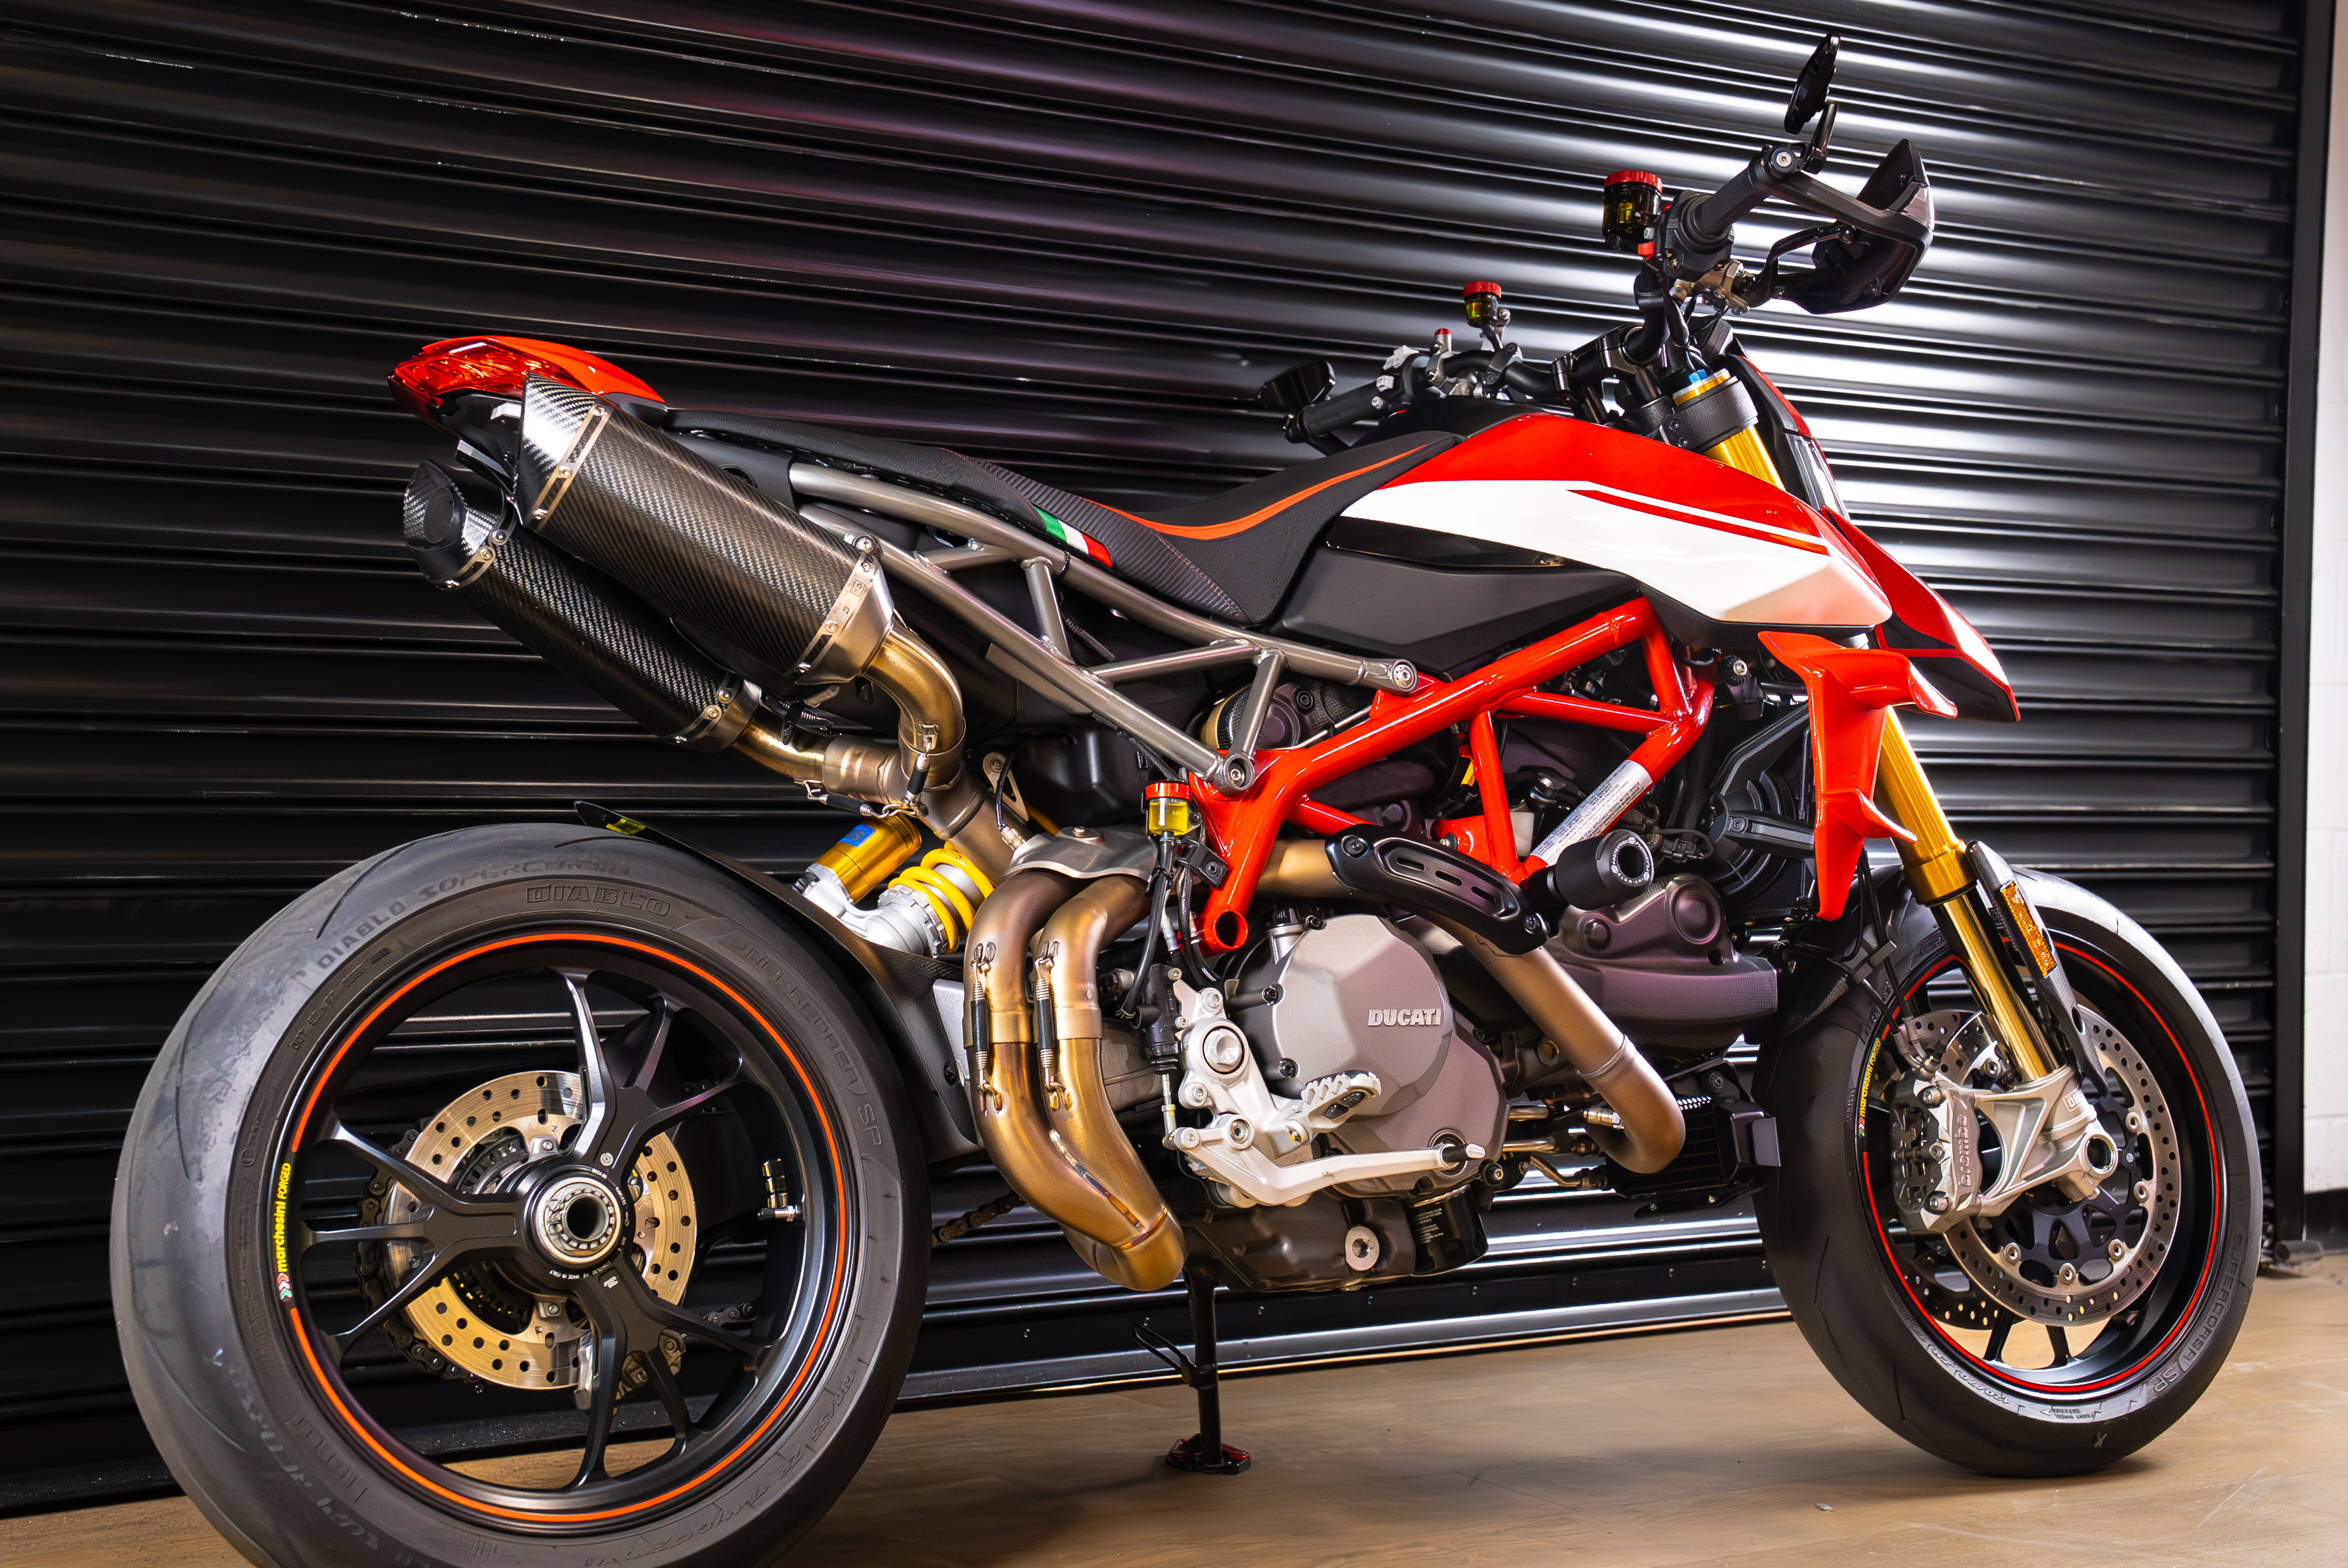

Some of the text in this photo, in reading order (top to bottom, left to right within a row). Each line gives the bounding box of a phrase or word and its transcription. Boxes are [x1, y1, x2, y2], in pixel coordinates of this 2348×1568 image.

[1612, 839, 1628, 865] PROTECTION
[317, 899, 406, 969] DIABLO
[527, 884, 670, 917] DIABLO
[858, 1103, 881, 1146] SP
[1368, 1009, 1441, 1026] DUCATI
[1859, 1062, 1875, 1118] marchesini
[1958, 1114, 1973, 1188] brembo
[272, 1163, 291, 1273] marchesini FORGED
[2155, 1234, 2243, 1392] SUPERCORSA SP
